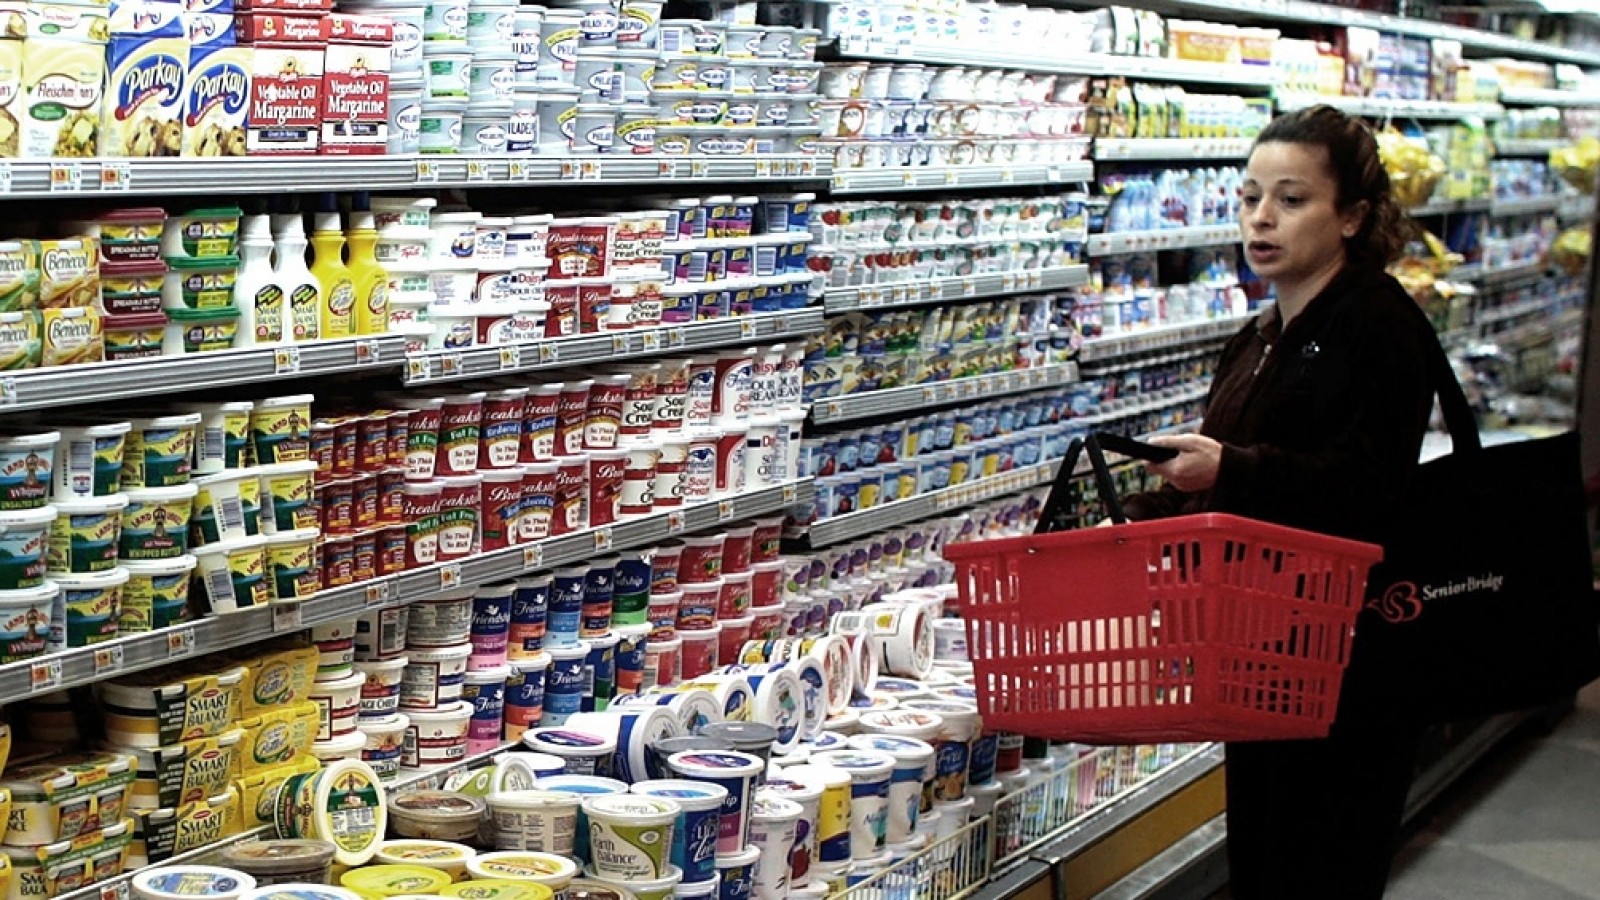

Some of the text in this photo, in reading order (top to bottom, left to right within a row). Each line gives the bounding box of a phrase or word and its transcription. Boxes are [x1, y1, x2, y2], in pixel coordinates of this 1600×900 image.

[125, 55, 181, 106] Parkay
[194, 64, 245, 115] Parkay
[329, 80, 385, 97] Vegetable Oil
[301, 85, 316, 100] Oil
[254, 100, 317, 127] Margarine
[326, 95, 386, 119] Margarine
[49, 251, 89, 271] Benecol
[53, 318, 93, 339] Benecol
[3, 458, 26, 476] LAND
[132, 512, 153, 528] LAND
[4, 615, 25, 630] LAND
[189, 690, 230, 713] SMART
[187, 707, 228, 728] BALANCE
[189, 751, 229, 774] SMART
[187, 768, 226, 788] BALANCE
[181, 810, 224, 834] SMART
[598, 848, 638, 864] balance
